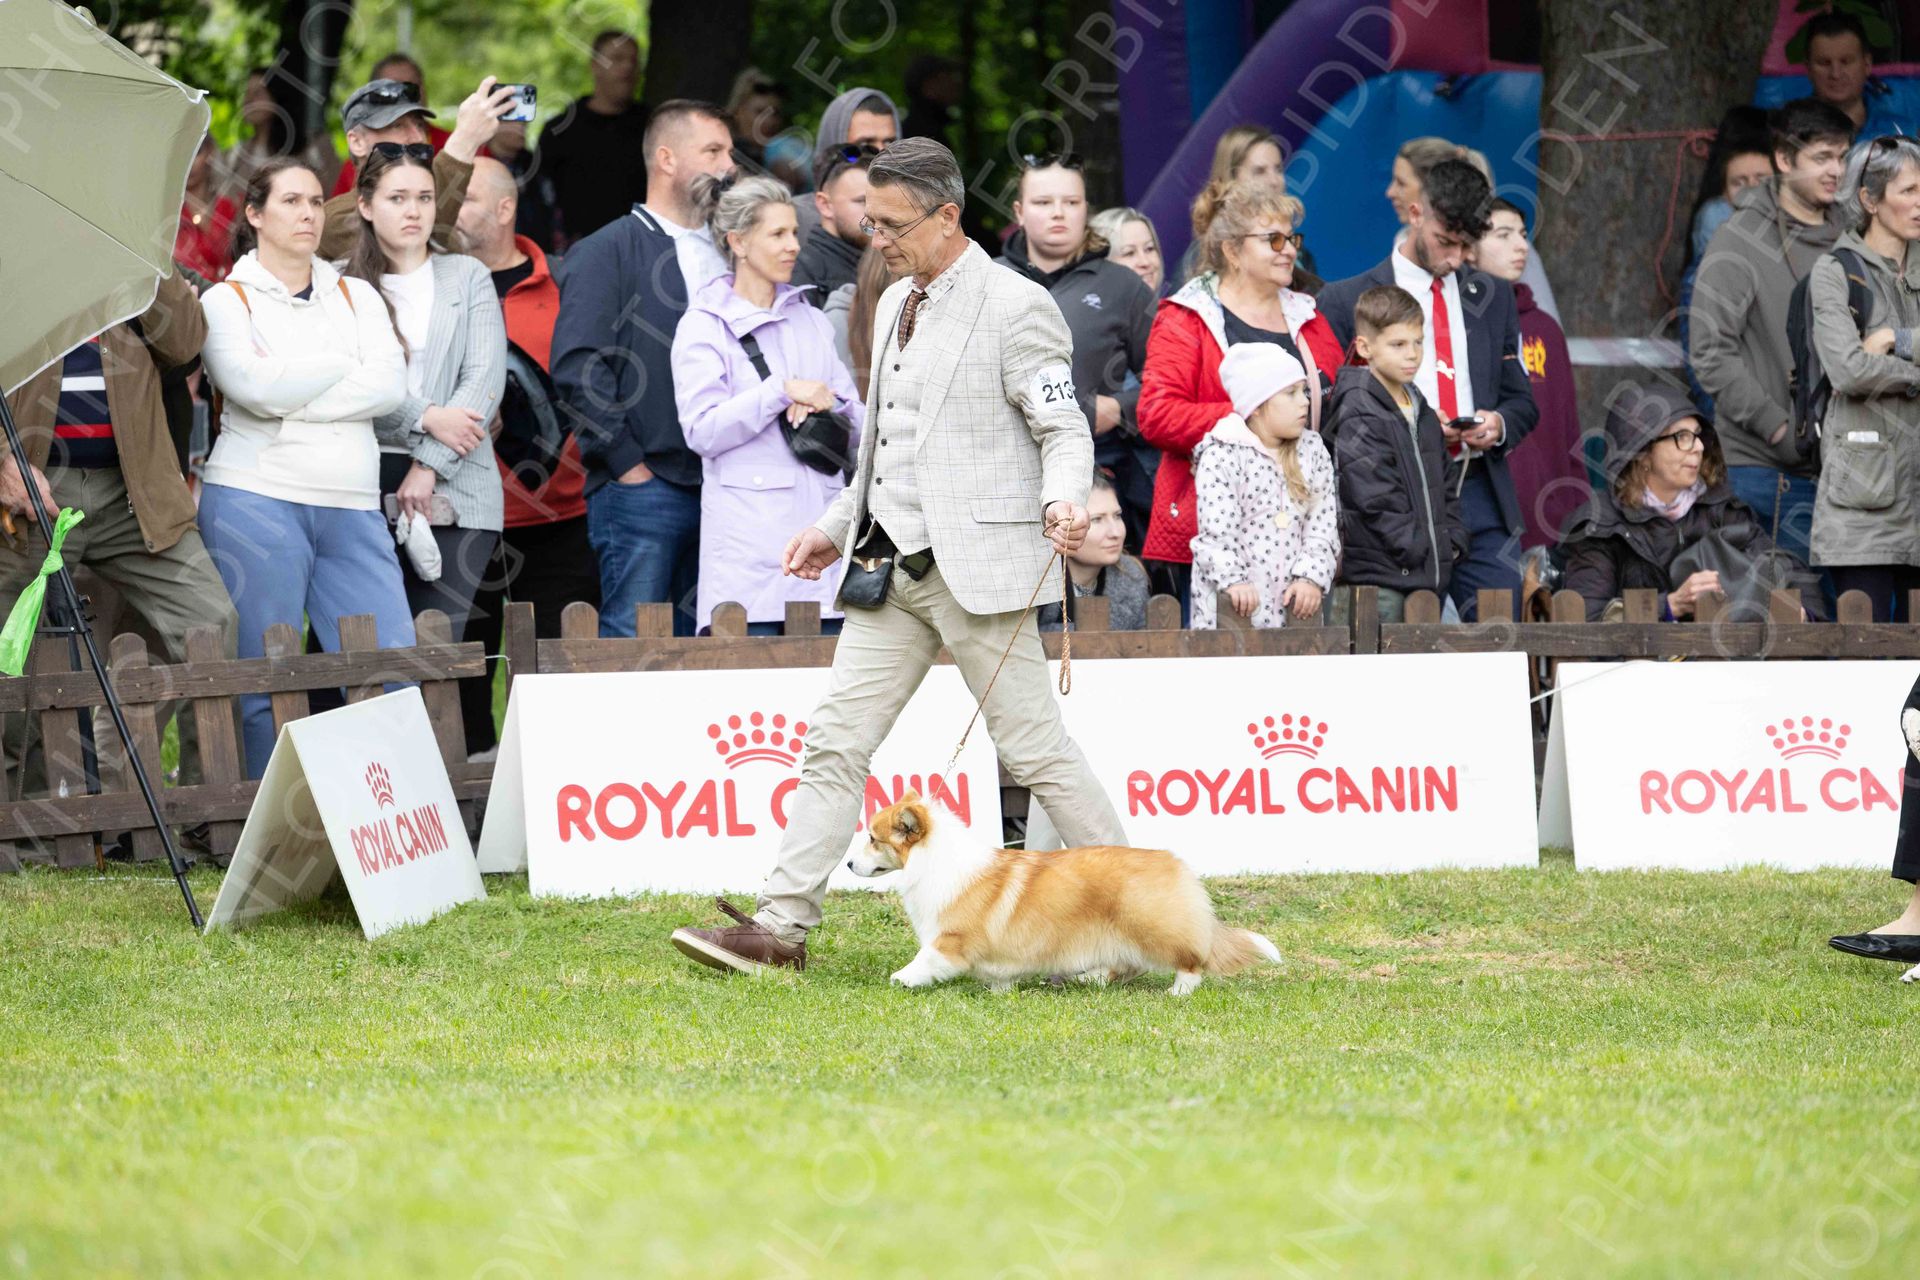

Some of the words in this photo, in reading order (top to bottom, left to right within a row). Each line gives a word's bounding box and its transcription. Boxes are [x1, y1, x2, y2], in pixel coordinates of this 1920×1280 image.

[1042, 381, 1073, 403] 213
[557, 779, 756, 842] ROYAL
[1127, 768, 1286, 816] ROYAL
[1297, 765, 1458, 814] CANIN
[1640, 768, 1807, 813] ROYAL
[1820, 767, 1905, 812] CA
[350, 817, 404, 877] ROYAL
[396, 803, 449, 862] CANIN
